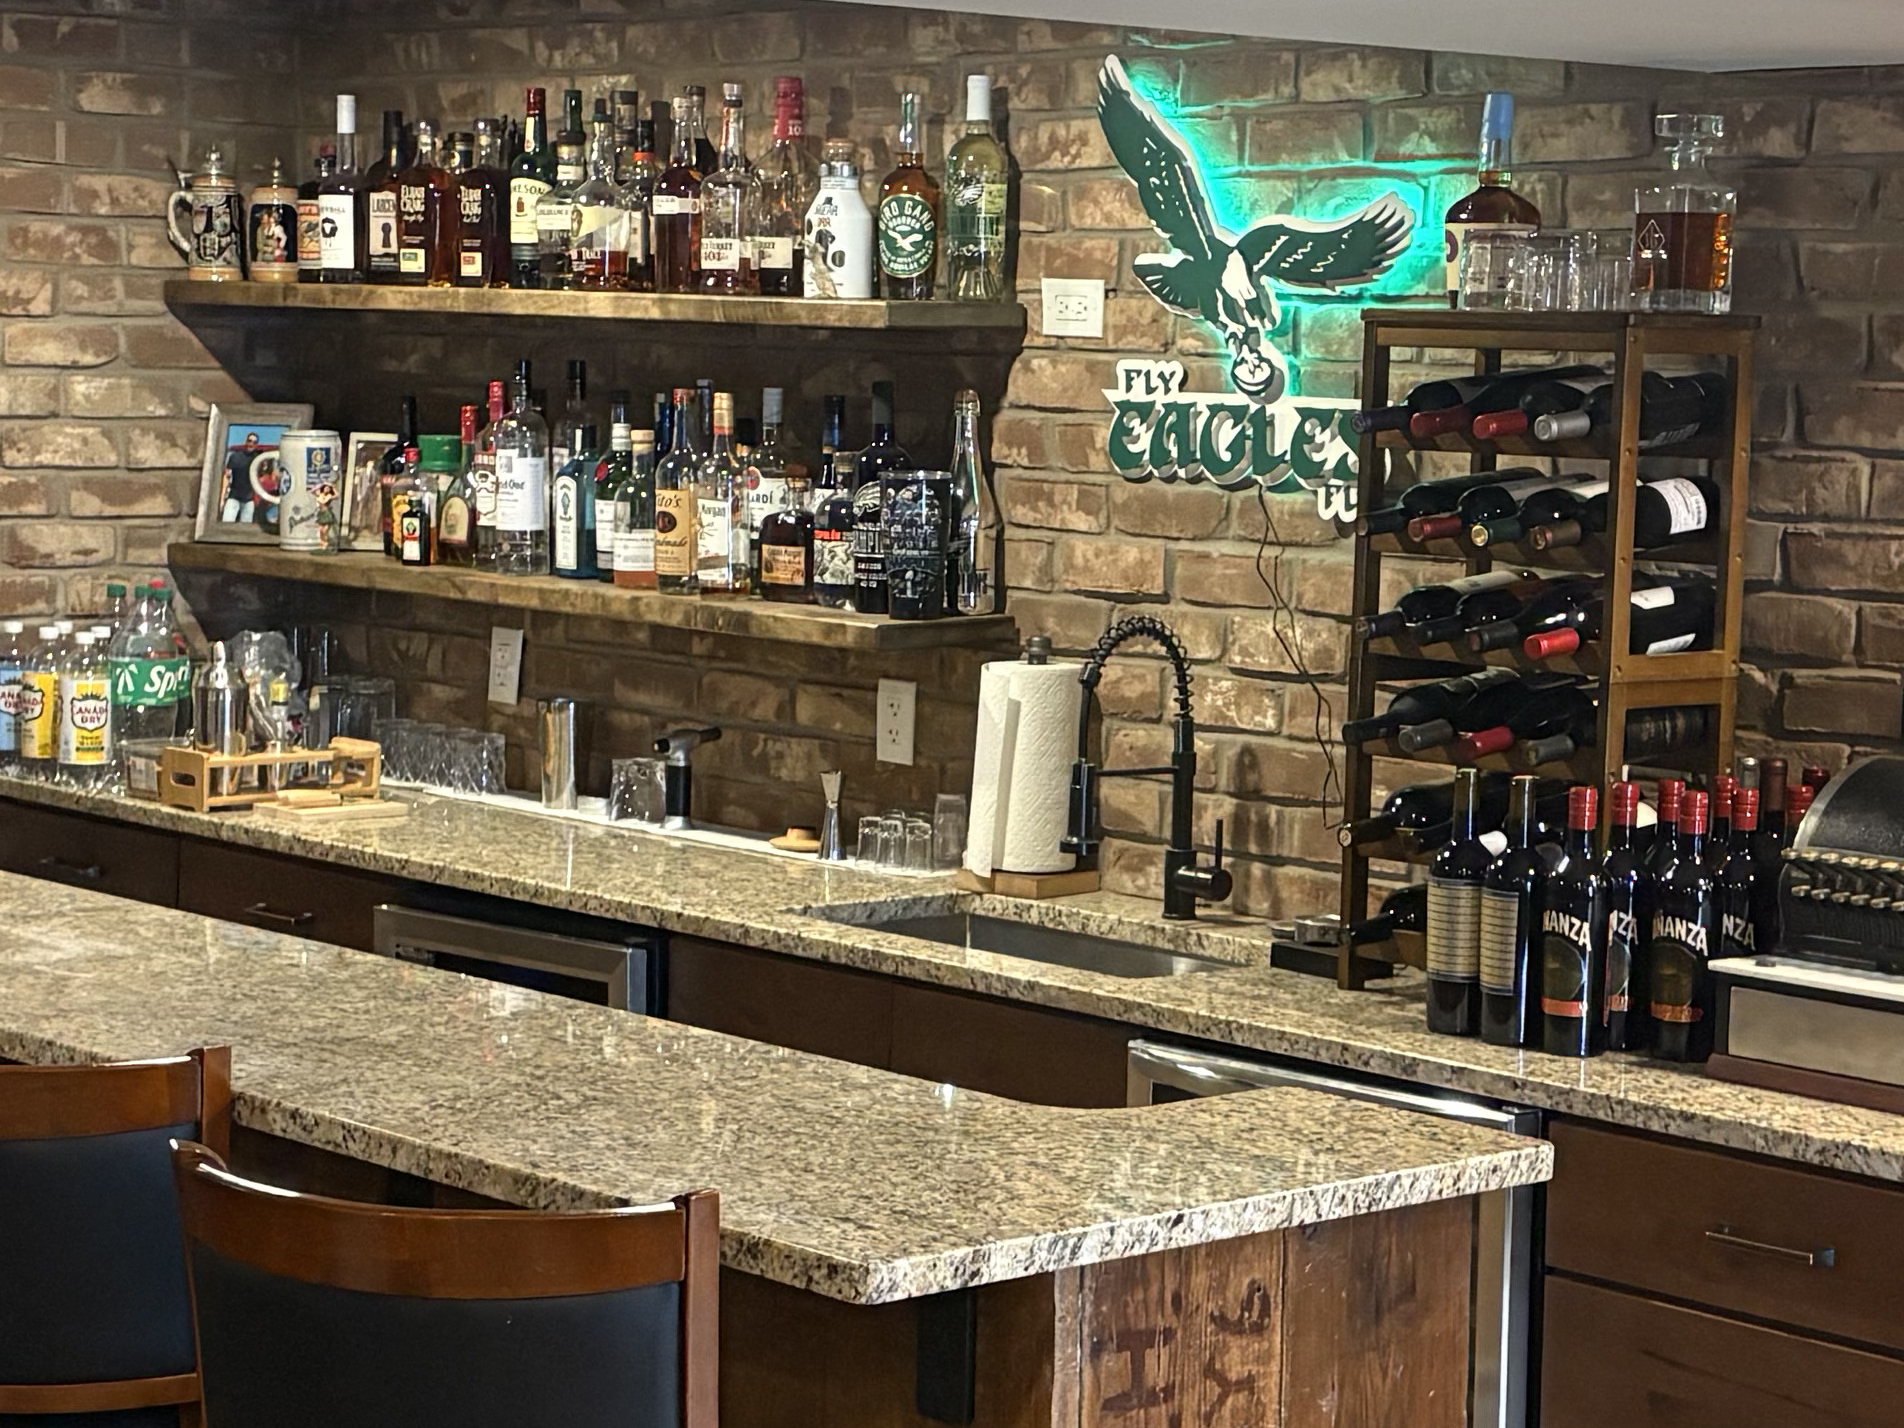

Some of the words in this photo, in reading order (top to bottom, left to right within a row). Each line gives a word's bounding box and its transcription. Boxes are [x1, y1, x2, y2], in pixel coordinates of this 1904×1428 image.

[1123, 368, 1176, 396] FLY
[1109, 400, 1360, 481] EAGLES
[1325, 484, 1359, 510] FL
